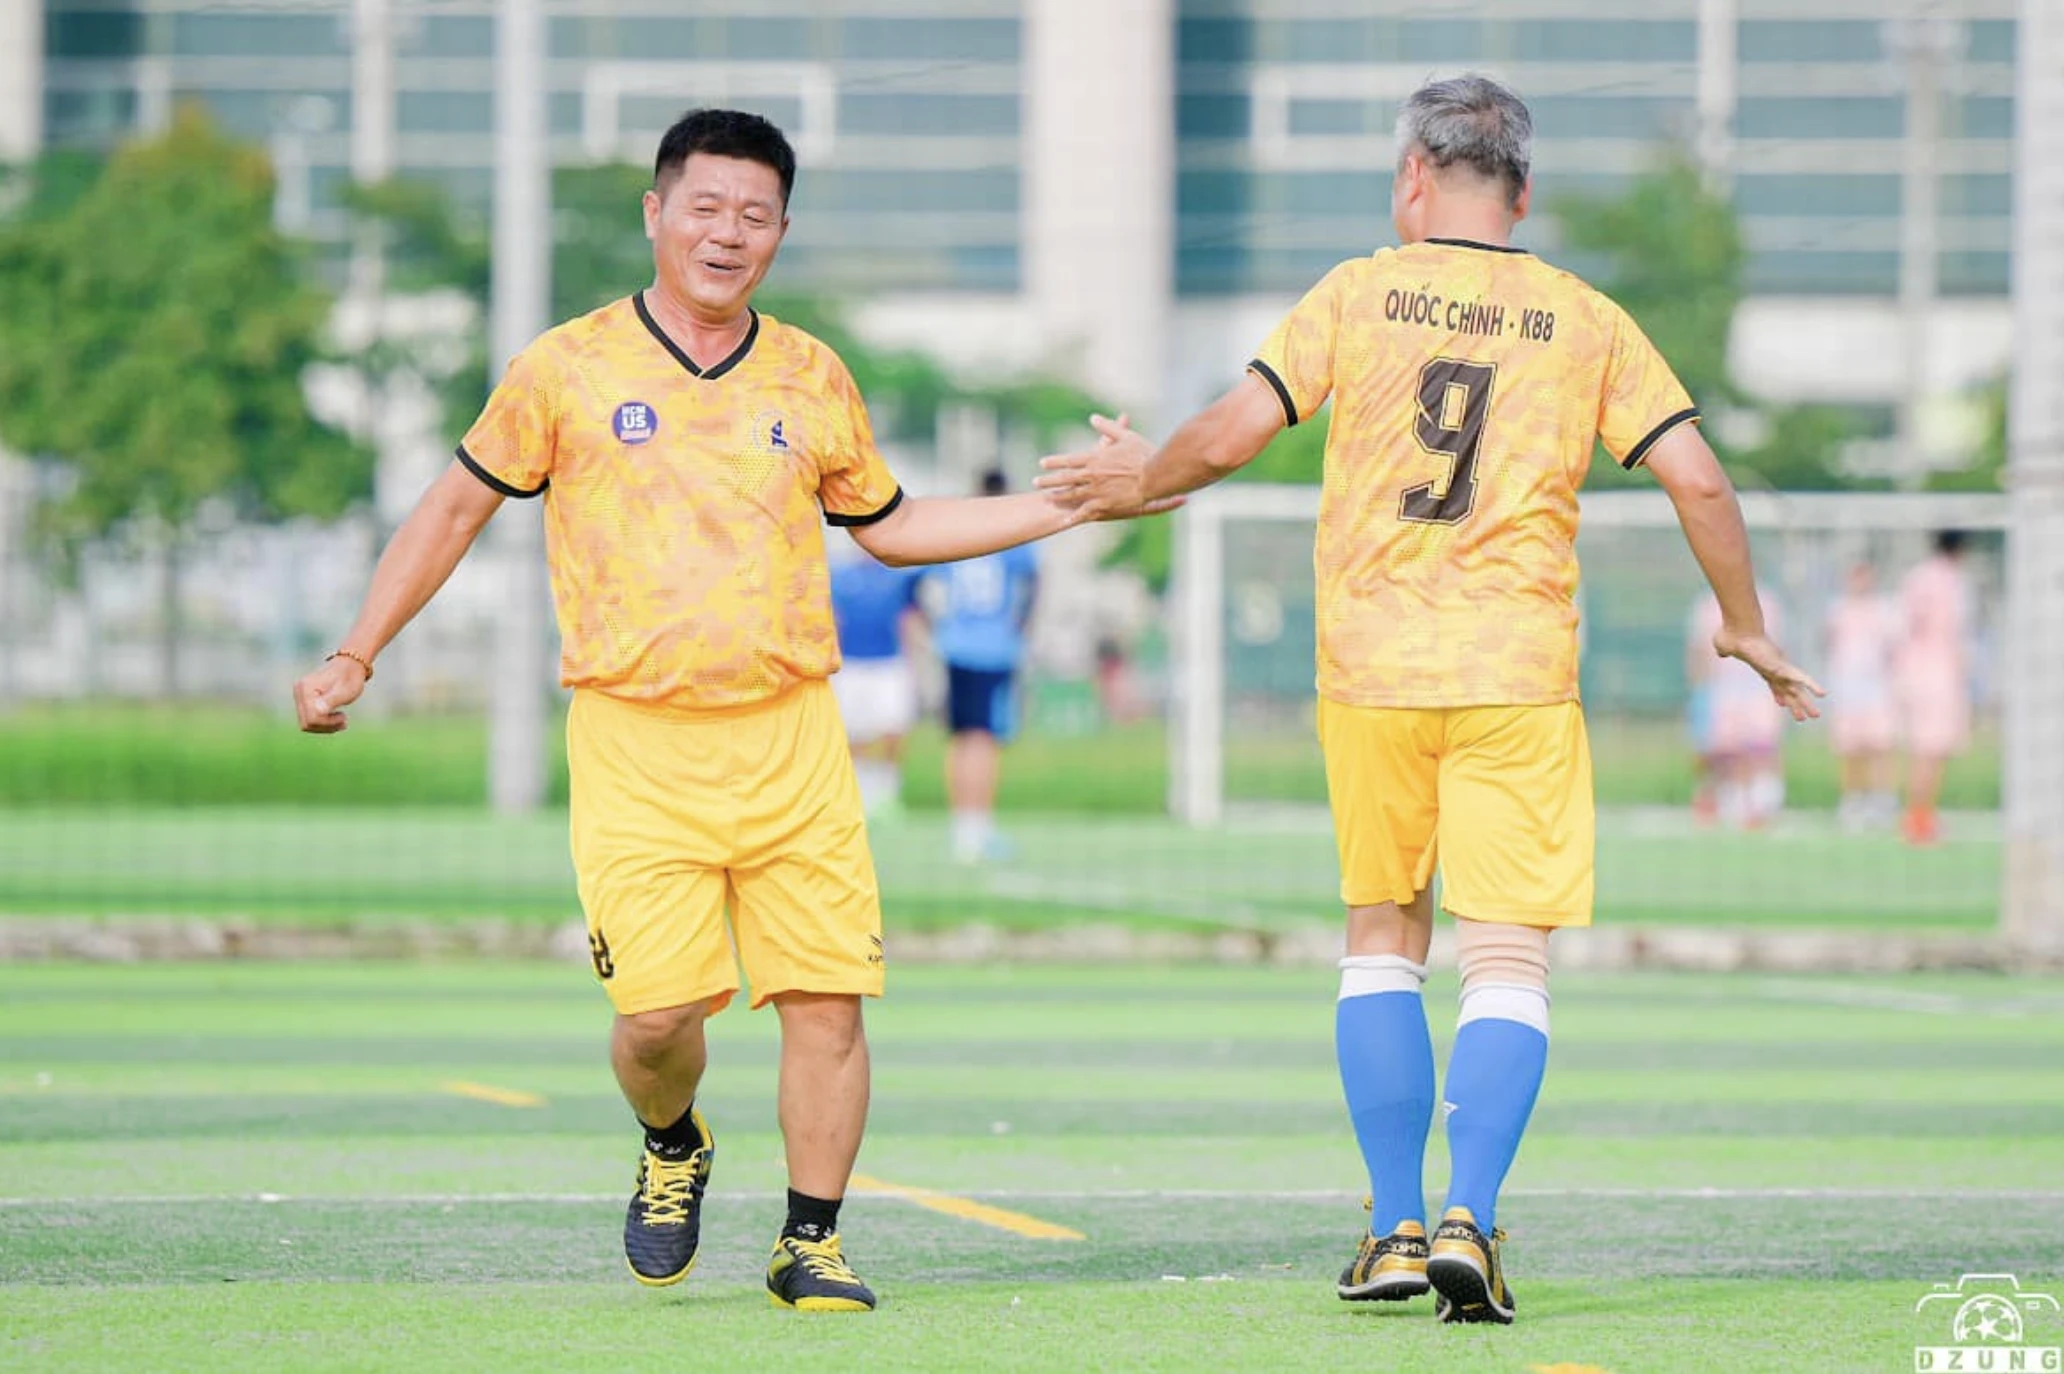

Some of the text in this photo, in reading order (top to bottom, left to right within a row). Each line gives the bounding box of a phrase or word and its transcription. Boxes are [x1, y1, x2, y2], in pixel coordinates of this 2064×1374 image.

[1385, 282, 1442, 327] QUỐC
[1446, 294, 1505, 336] CHÍNH
[1520, 308, 1555, 342] K88
[622, 415, 648, 429] US
[1398, 356, 1498, 526] 9
